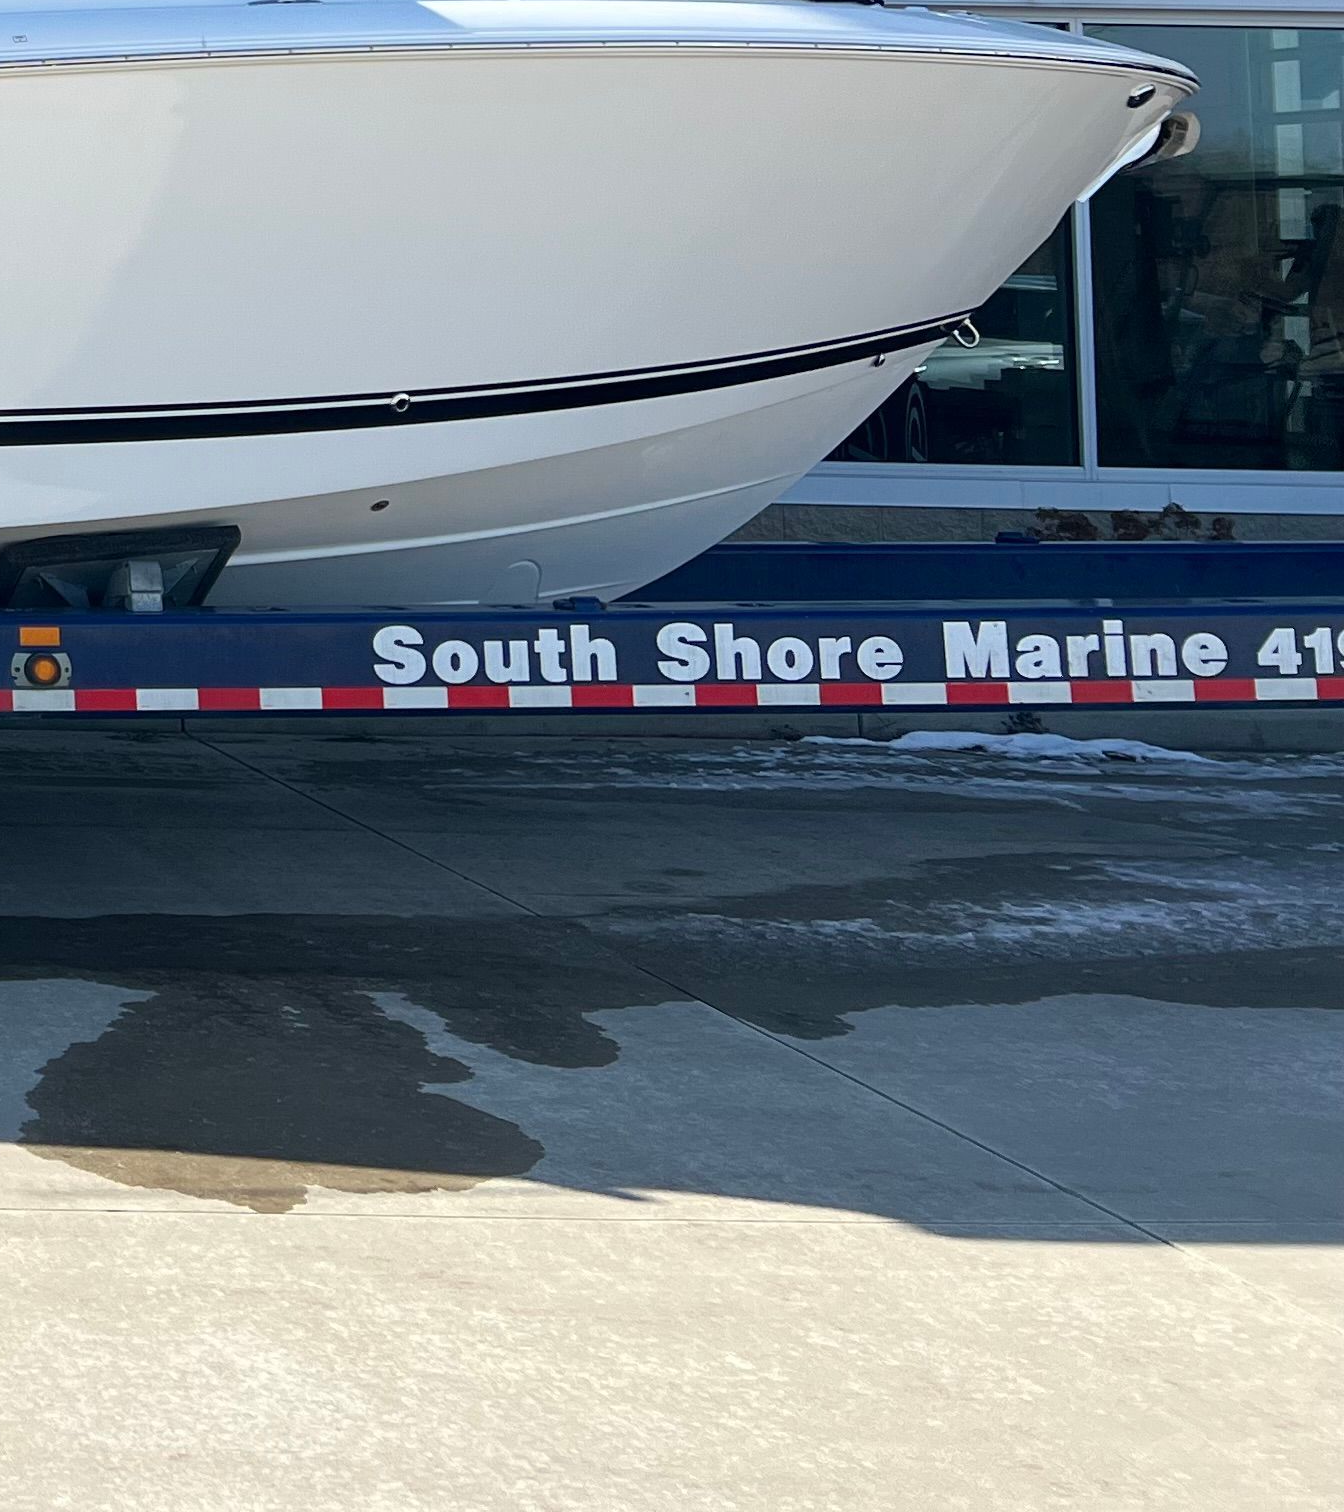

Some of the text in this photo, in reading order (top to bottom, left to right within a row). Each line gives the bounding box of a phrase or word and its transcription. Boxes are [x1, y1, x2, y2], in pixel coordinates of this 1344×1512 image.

[371, 619, 1344, 685] South Shore Marine 41
